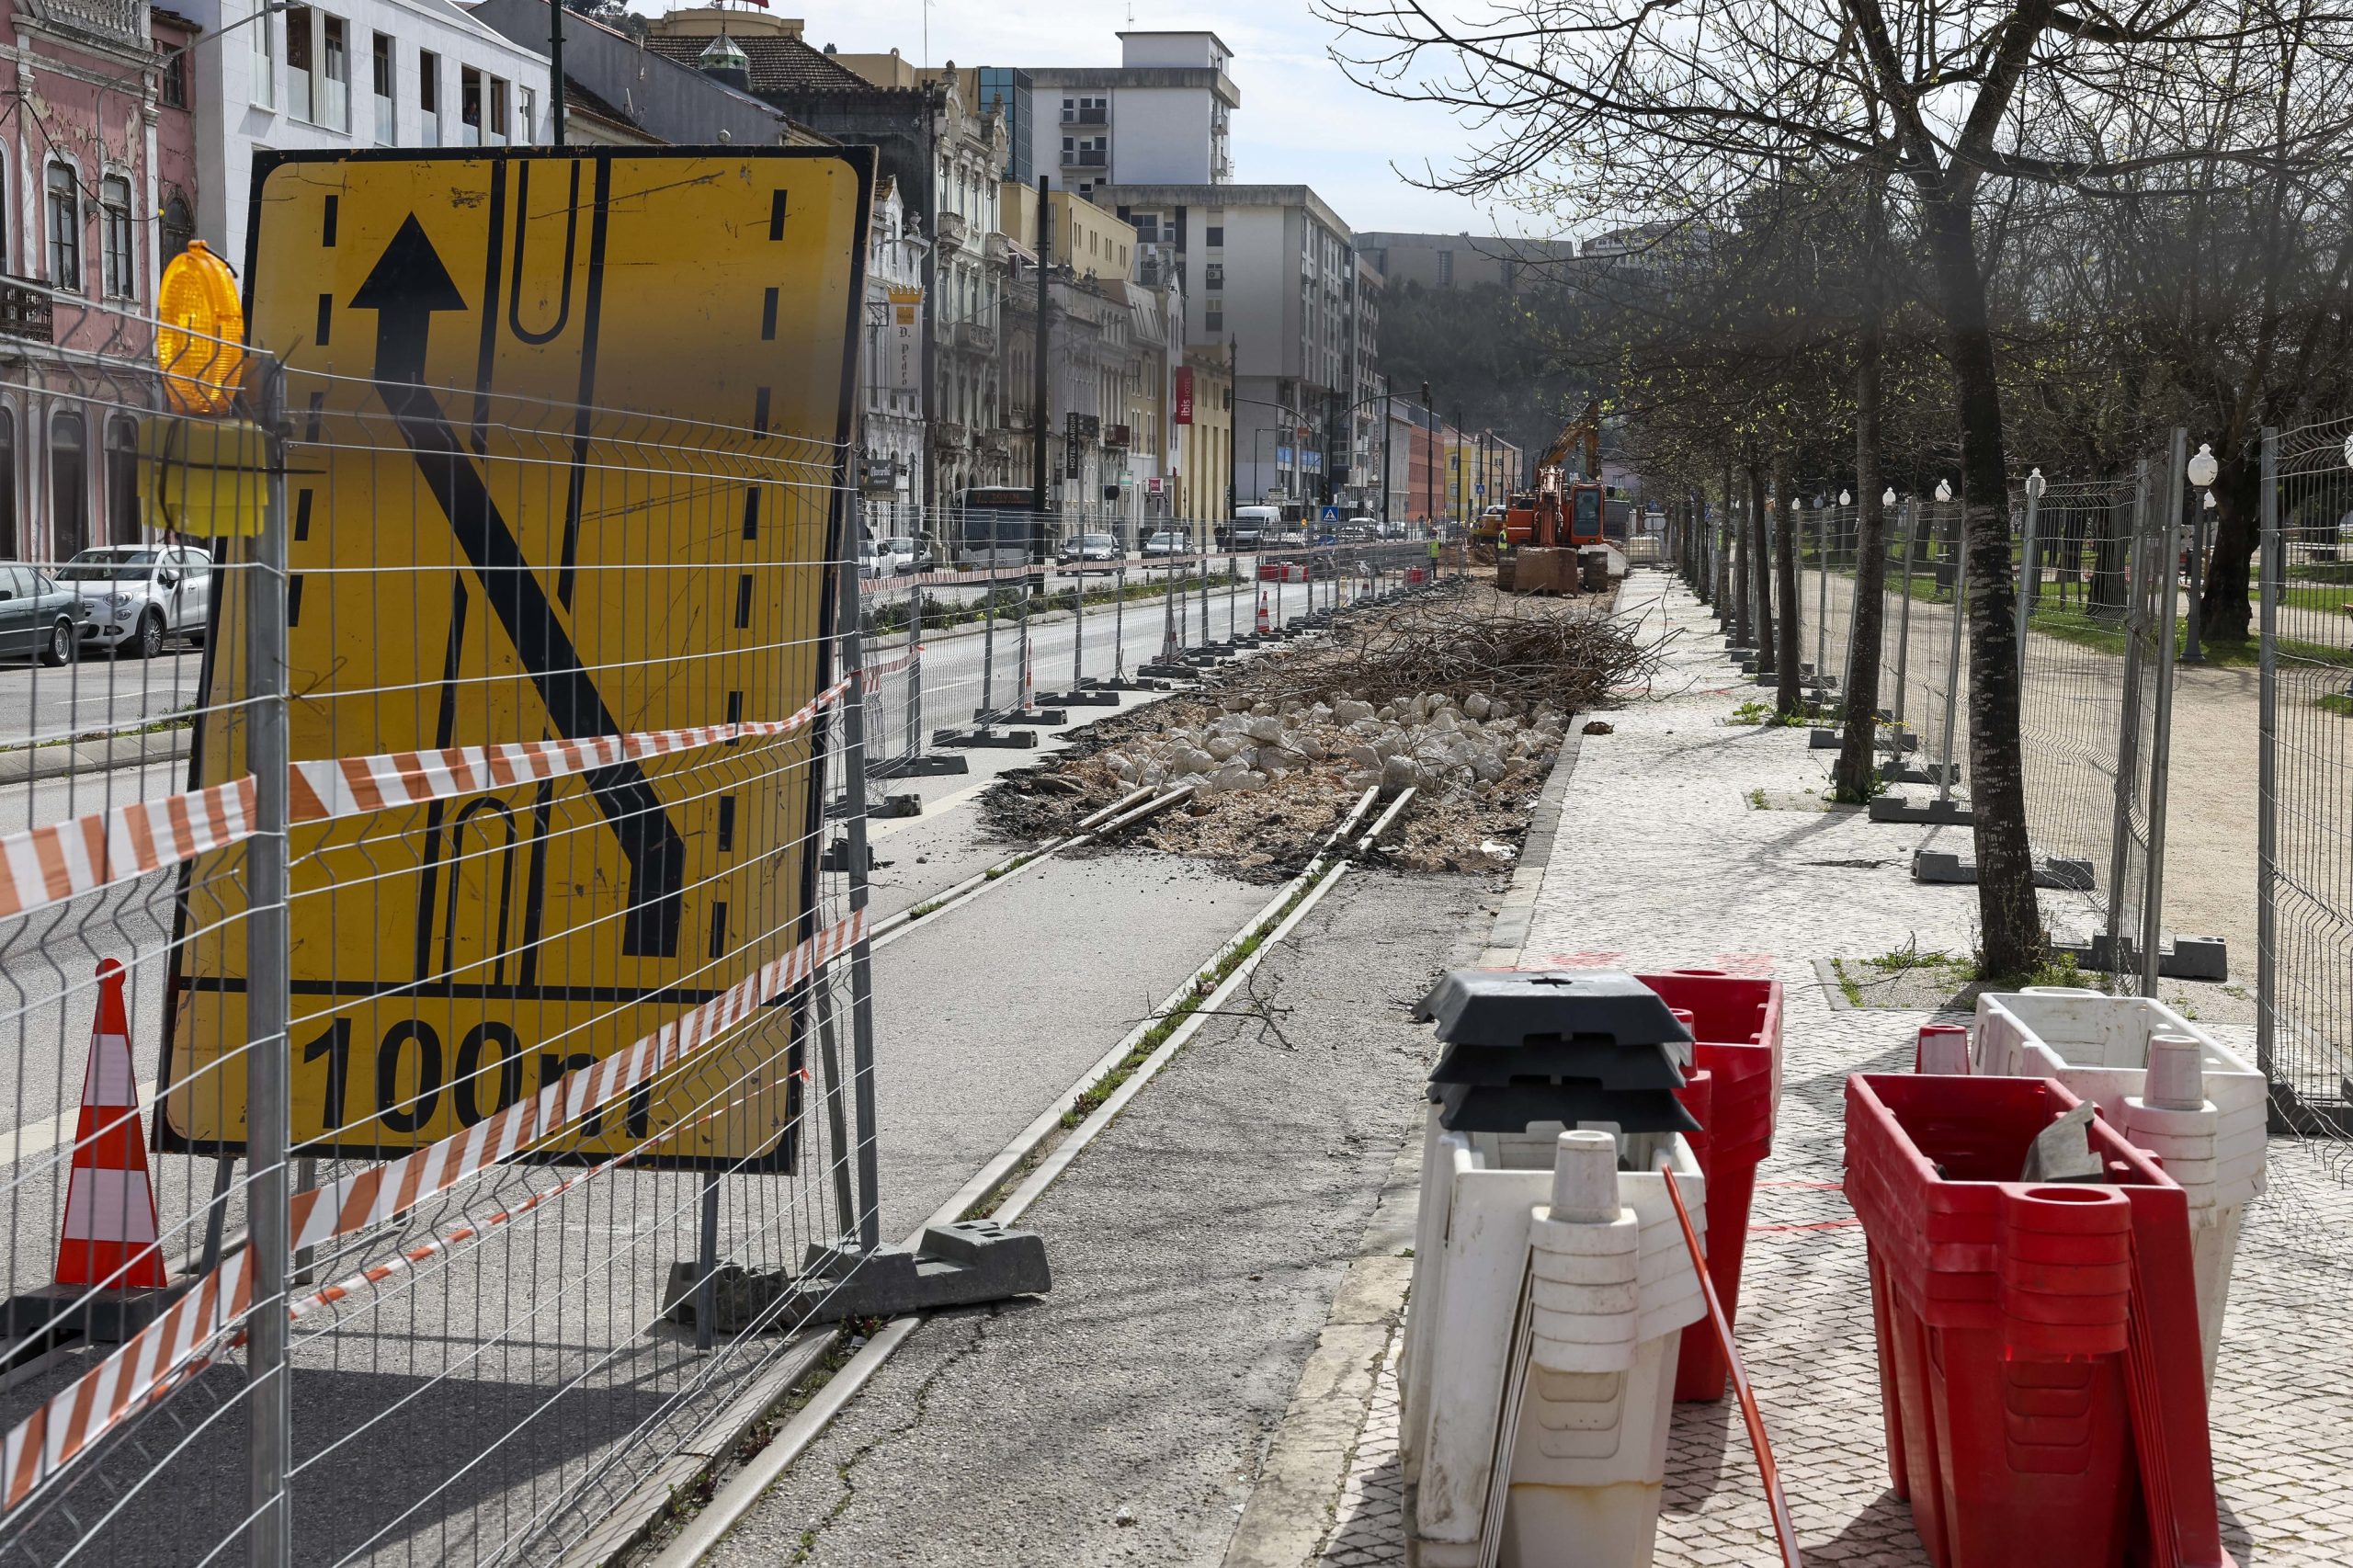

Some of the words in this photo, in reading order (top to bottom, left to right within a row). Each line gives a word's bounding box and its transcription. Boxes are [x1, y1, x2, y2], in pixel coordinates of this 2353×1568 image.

[899, 326, 911, 338] D.
[901, 344, 909, 386] Pedro
[1180, 399, 1191, 416] ibis
